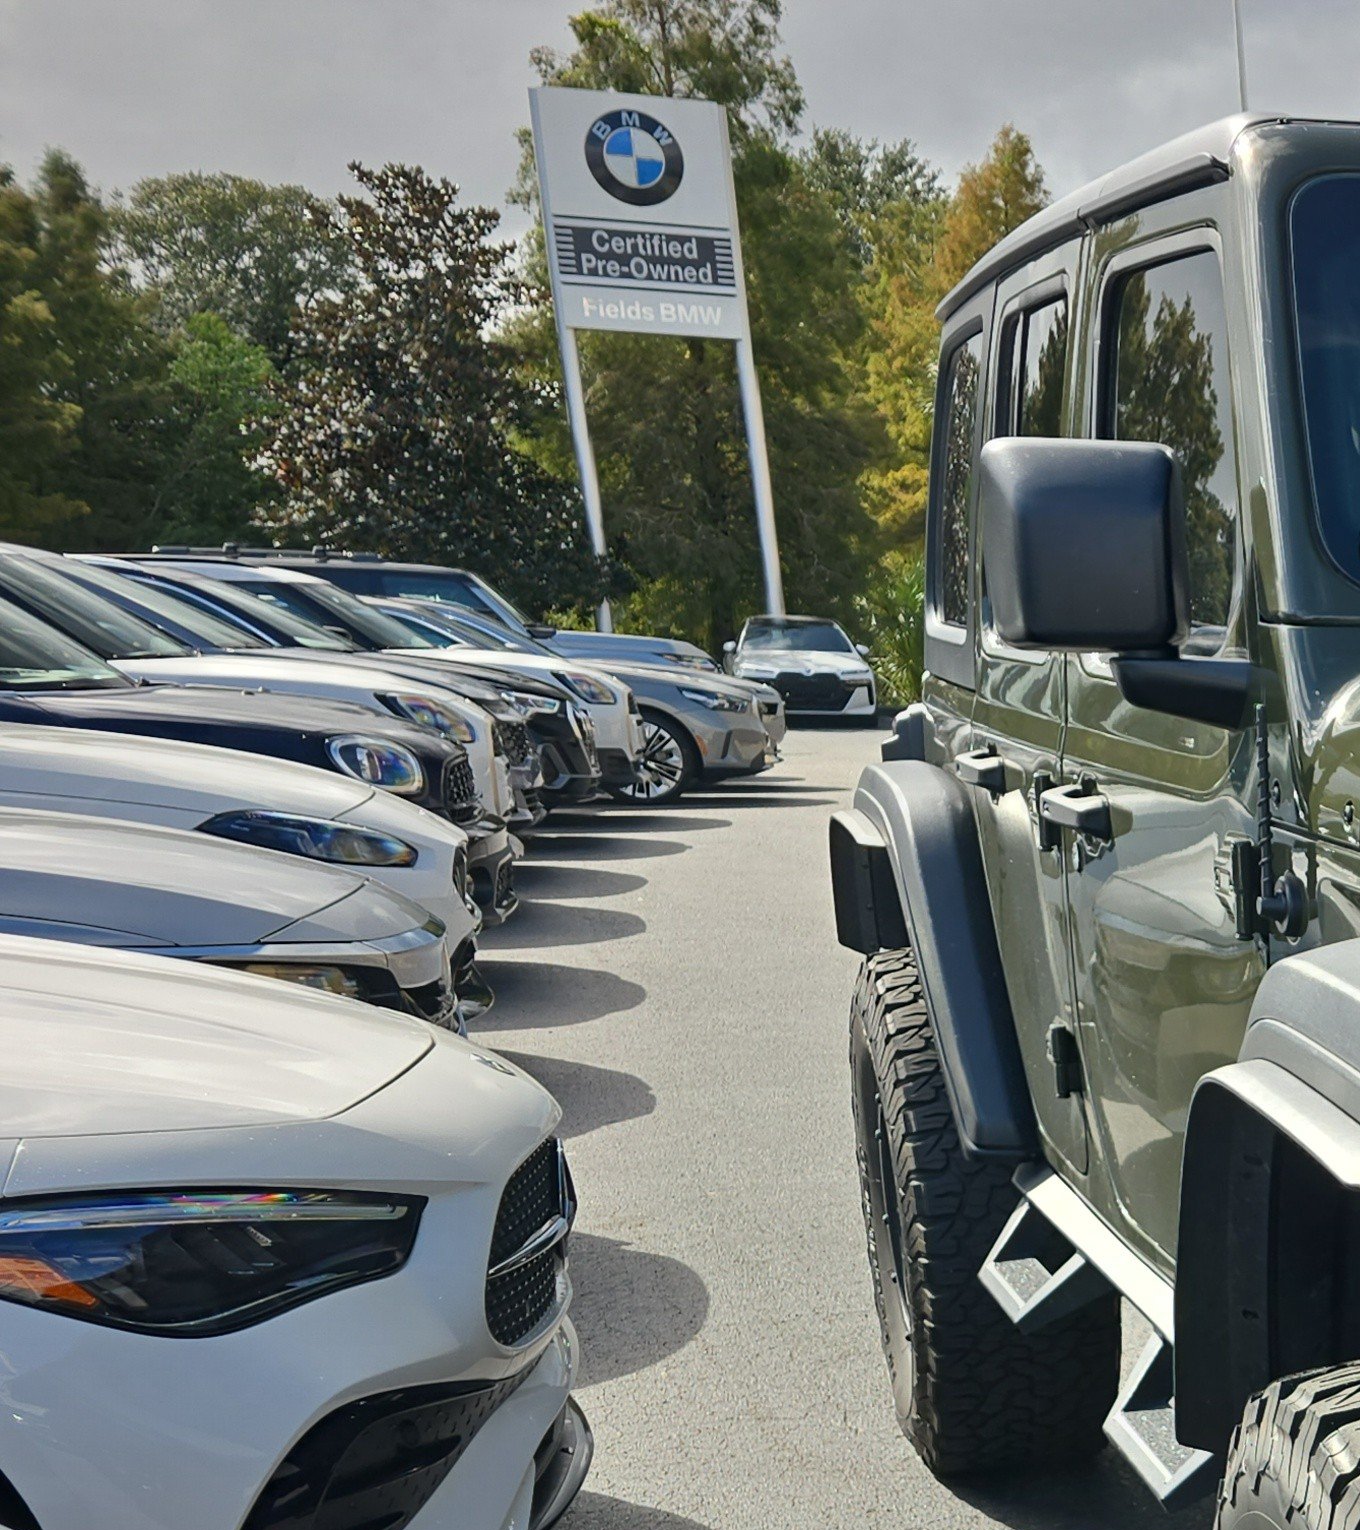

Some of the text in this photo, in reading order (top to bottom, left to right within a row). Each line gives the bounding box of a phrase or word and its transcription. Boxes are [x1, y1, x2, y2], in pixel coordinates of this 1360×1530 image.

[592, 111, 674, 146] BMW
[591, 229, 698, 259] Certified
[581, 253, 713, 284] Pre-Owned
[583, 297, 722, 326] Fields BMW
